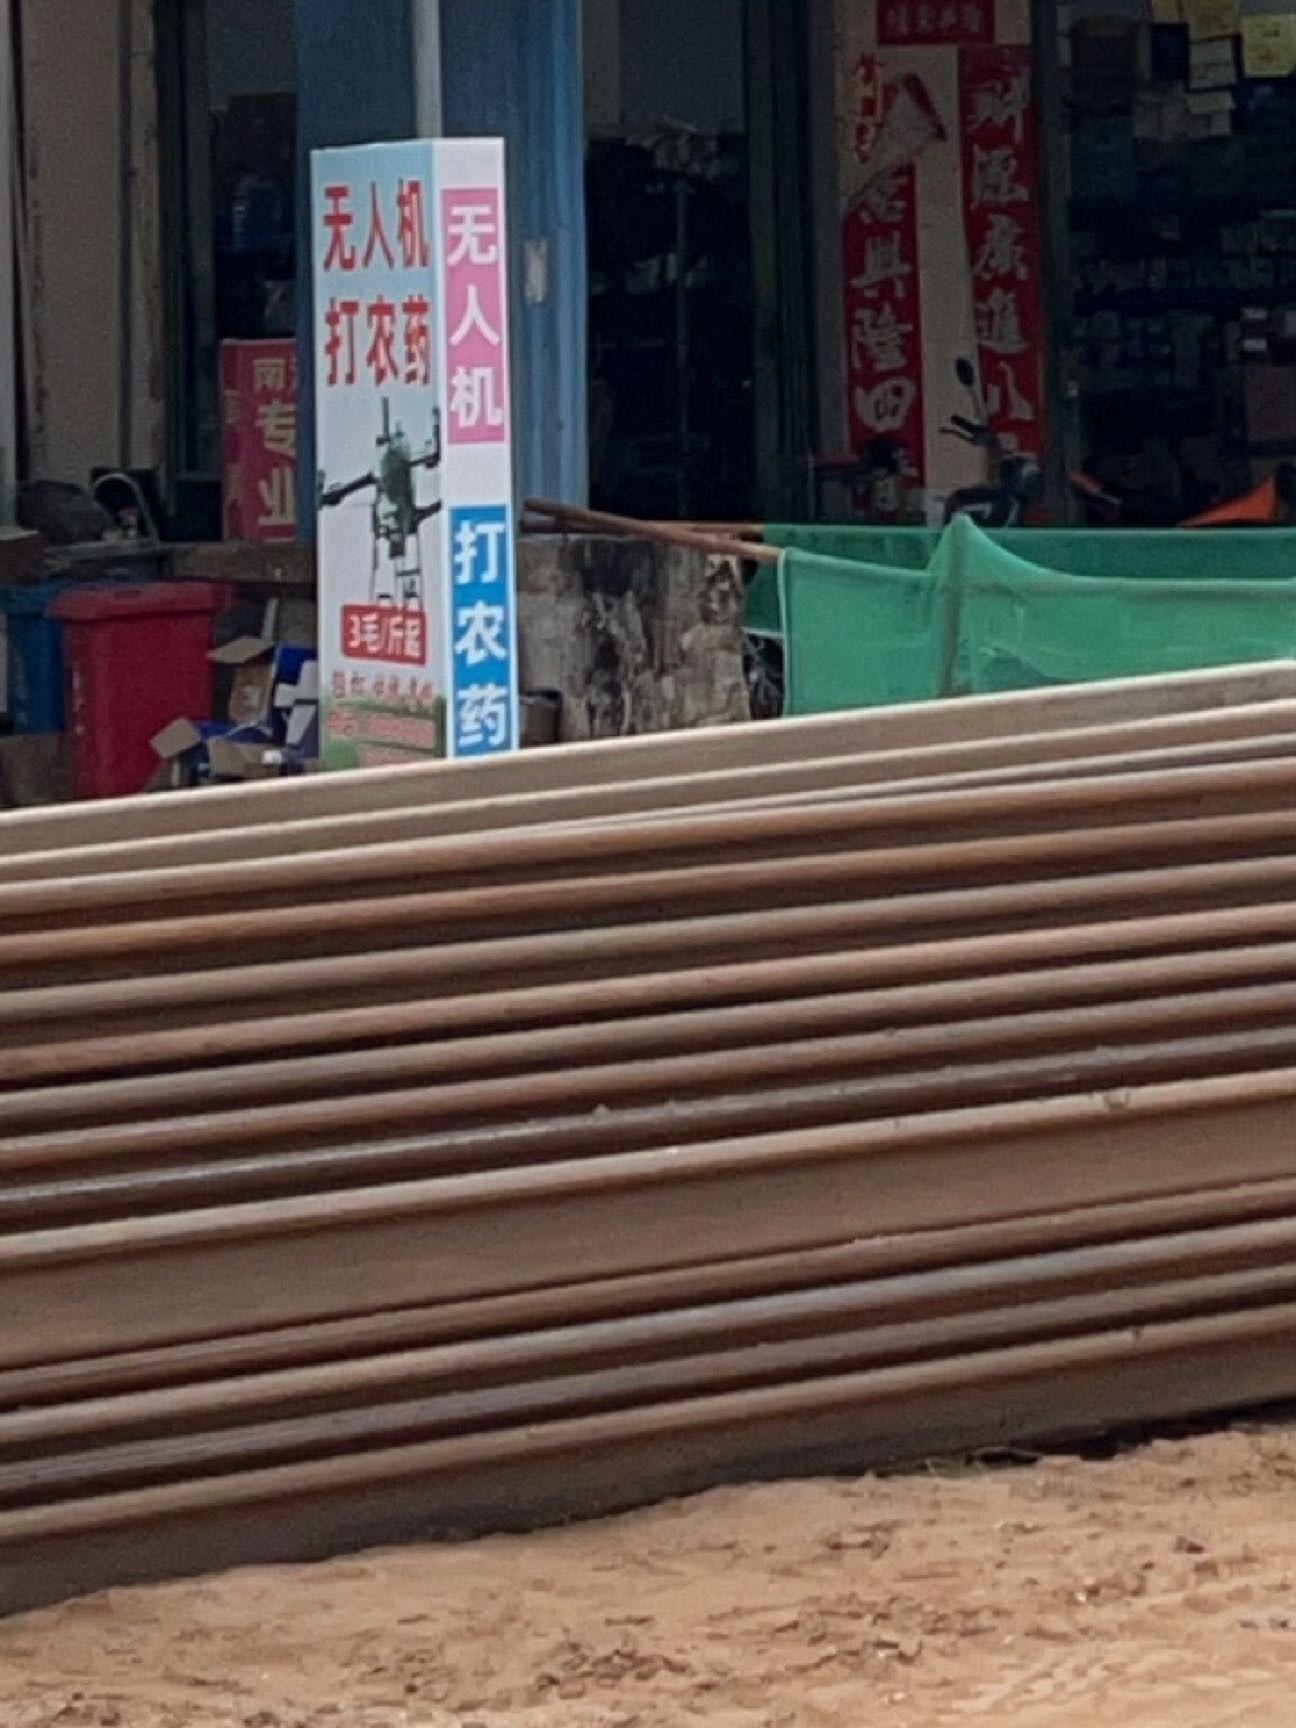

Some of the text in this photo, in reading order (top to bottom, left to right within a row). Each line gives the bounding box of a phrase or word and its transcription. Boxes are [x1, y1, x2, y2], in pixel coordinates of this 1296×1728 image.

[323, 178, 430, 271] 无人机
[324, 294, 431, 387] 打农药
[446, 203, 502, 429] 无人机
[454, 519, 508, 747] 打农药
